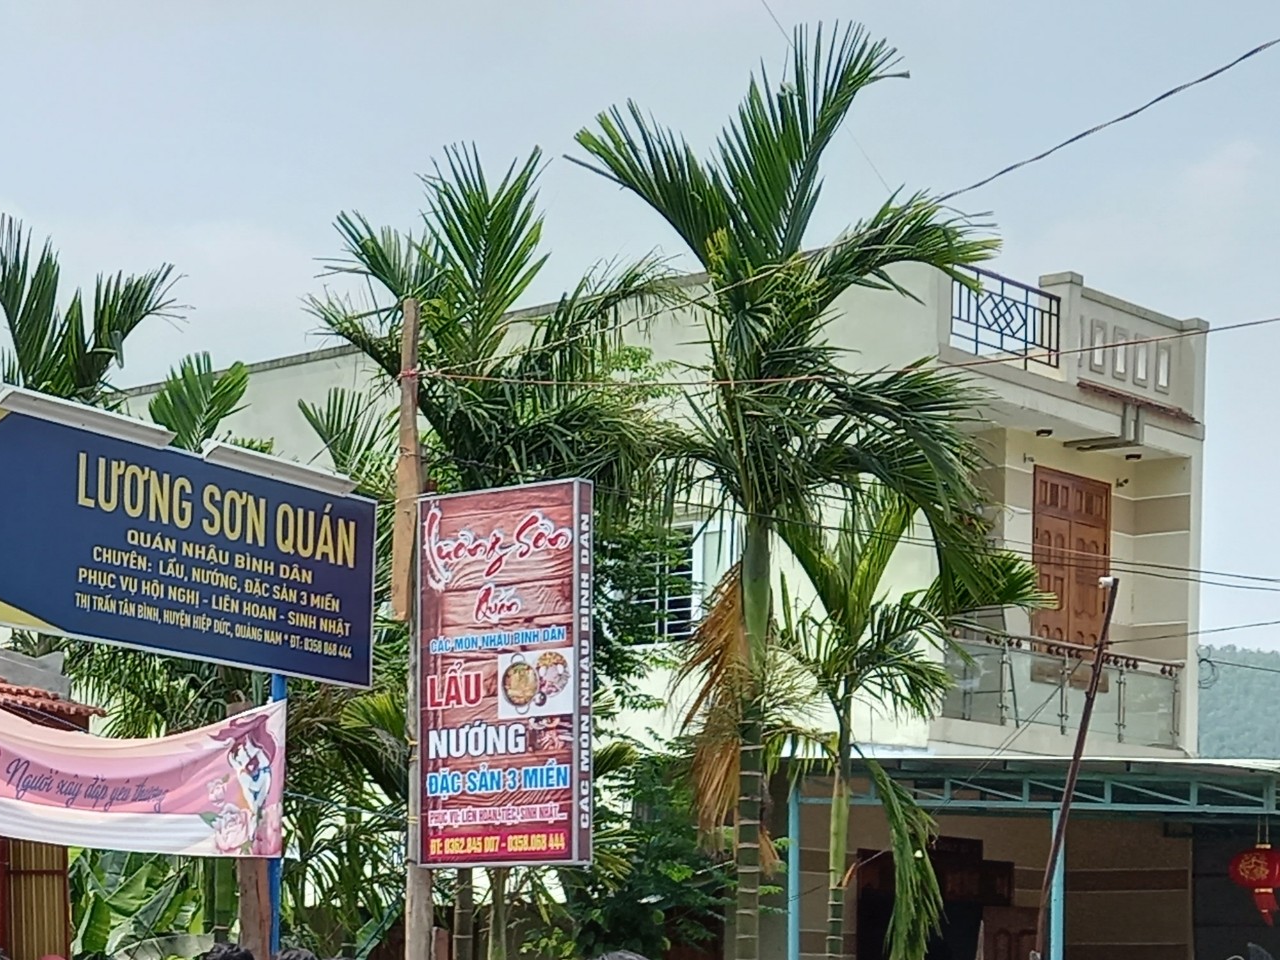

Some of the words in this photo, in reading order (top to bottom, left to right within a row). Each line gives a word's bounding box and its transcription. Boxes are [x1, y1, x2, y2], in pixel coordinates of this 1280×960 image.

[77, 452, 192, 529] LƯƠNG
[202, 484, 266, 547] SƠN
[276, 504, 356, 568] QUÁN
[93, 546, 152, 572] CHUYÊN:
[192, 566, 241, 593] NƯỚNG,
[245, 578, 270, 598] ĐẶC
[300, 591, 307, 606] 3
[127, 528, 176, 553] QUÁN
[182, 540, 229, 565] NHẬU
[234, 552, 274, 576] BÌNH
[280, 564, 312, 584] DÂN
[75, 592, 90, 612] THỊ
[119, 598, 136, 618] TÂN
[264, 630, 282, 645] NAM
[78, 567, 116, 590] PHỤC
[119, 575, 138, 596] VỤ
[141, 580, 164, 600] HỘI
[168, 585, 199, 608] NGHỊ
[212, 594, 239, 613] LIÊN
[243, 601, 277, 621] HOAN
[288, 611, 316, 630] SINH
[320, 618, 351, 637] NHẬT
[427, 662, 482, 709] LẨU
[428, 721, 526, 759] NƯỚNG
[428, 769, 461, 800] ĐẶC
[467, 764, 501, 792] SẢN
[507, 770, 518, 789] 3
